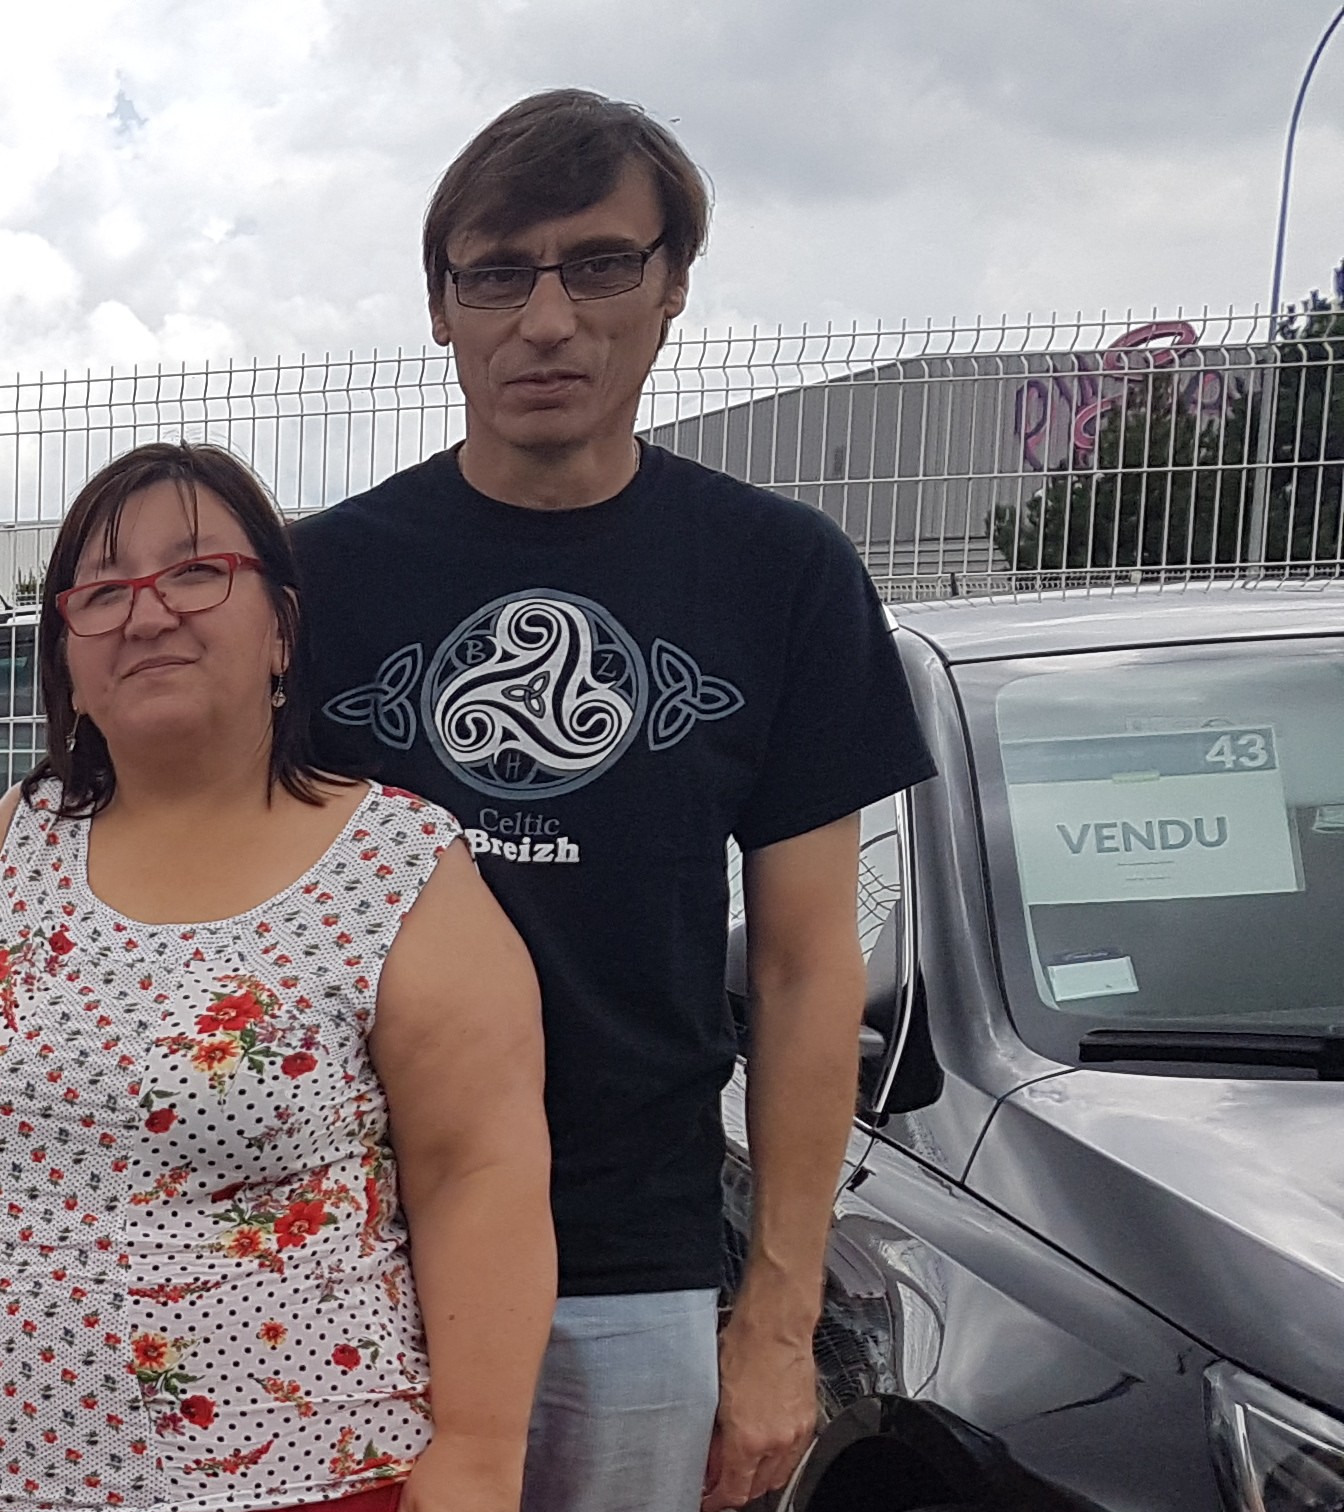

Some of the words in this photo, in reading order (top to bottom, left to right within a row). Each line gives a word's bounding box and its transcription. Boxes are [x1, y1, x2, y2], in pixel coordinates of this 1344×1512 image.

[464, 640, 486, 665] B
[1205, 733, 1269, 768] 43
[479, 808, 560, 836] Celtic
[1056, 816, 1229, 855] VENDU
[465, 828, 580, 862] Breizh
